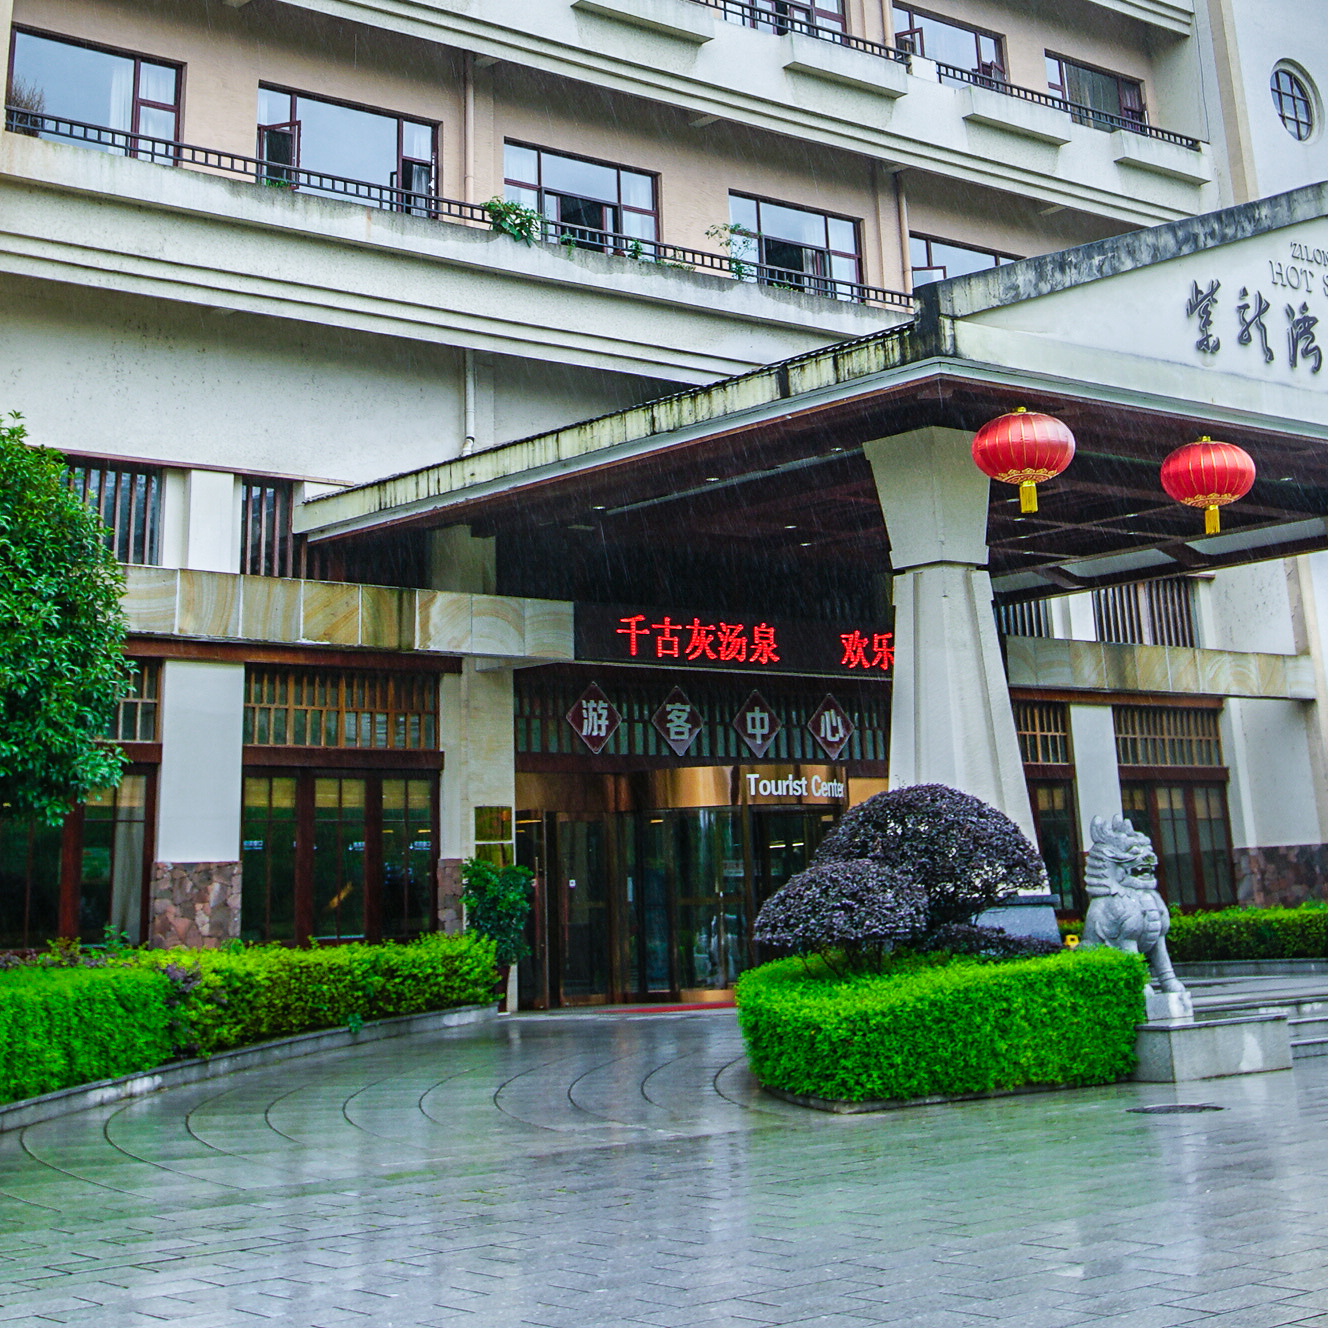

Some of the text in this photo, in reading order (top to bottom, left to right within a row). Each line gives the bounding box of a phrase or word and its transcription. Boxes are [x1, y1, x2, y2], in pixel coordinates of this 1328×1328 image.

[1269, 260, 1314, 293] HOT
[616, 615, 780, 664] 千古灰汤泉
[582, 699, 844, 743] 游客中心
[746, 773, 844, 798] Tourist Center
